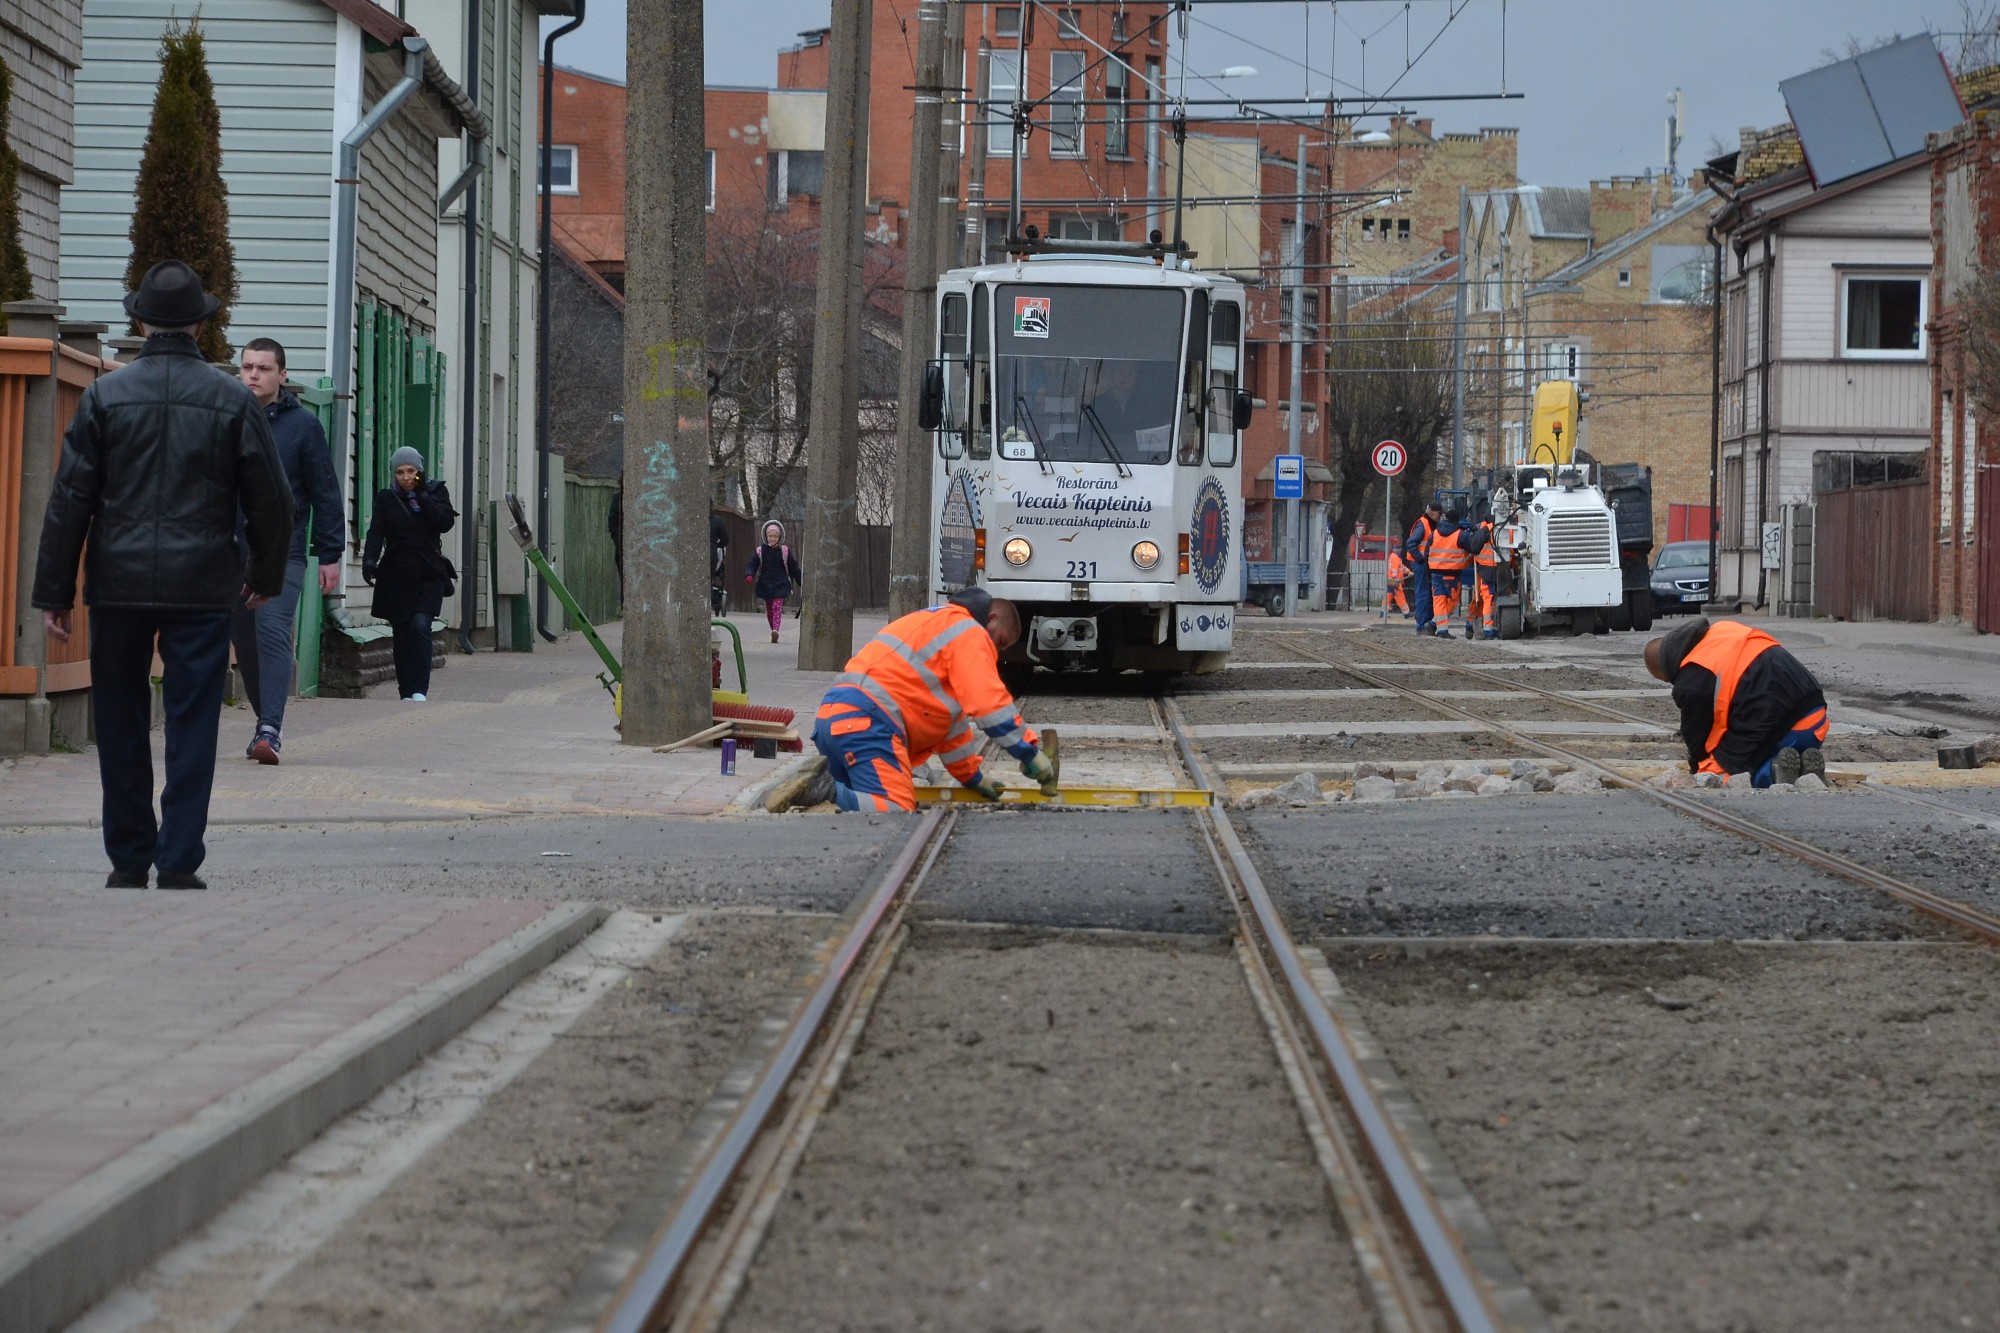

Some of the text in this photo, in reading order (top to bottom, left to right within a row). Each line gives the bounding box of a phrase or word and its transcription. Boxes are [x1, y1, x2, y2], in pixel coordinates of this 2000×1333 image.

[1013, 448, 1026, 457] 68
[1381, 450, 1397, 466] 20
[1056, 475, 1119, 490] Restorāns
[1011, 491, 1153, 515] Vecais Kapteinis
[1016, 515, 1151, 531] www.vecaiskapteinis.lv
[1066, 560, 1097, 579] 231
